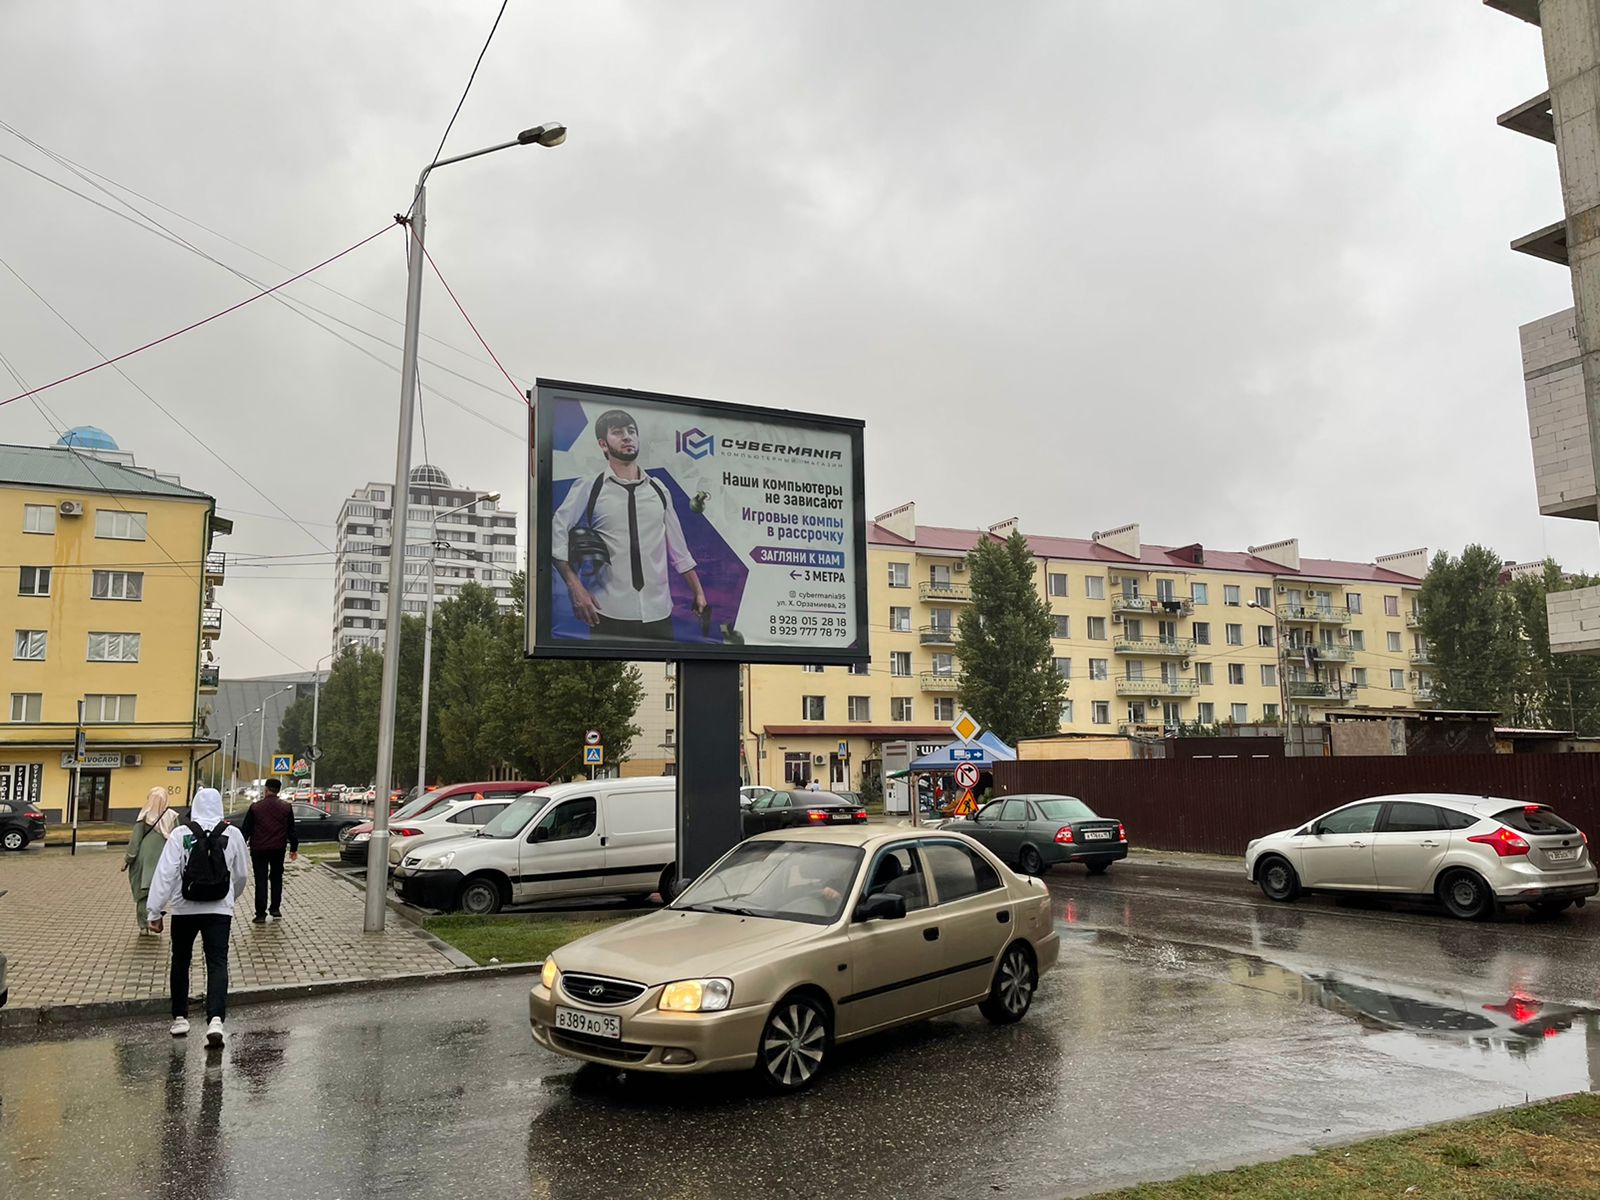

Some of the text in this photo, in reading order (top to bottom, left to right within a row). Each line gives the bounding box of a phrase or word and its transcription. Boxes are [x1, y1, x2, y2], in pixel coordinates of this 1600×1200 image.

[721, 438, 842, 460] CYBERMANIA
[804, 459, 843, 468] МАГАЗИН
[722, 472, 843, 497] Наши компьютеры
[765, 493, 843, 509] не зависают
[742, 507, 843, 528] Игровые компы
[767, 526, 844, 545] в рассрочку
[760, 549, 840, 565] ЗАГЛЯНИ К НАМ
[804, 570, 845, 583] 3 МЕТРА
[798, 592, 846, 600] cybermania95
[769, 615, 846, 627] 8 928 015 28 18
[770, 625, 846, 637] 8 929 777 78 79
[559, 1012, 616, 1033] В389АО 95
